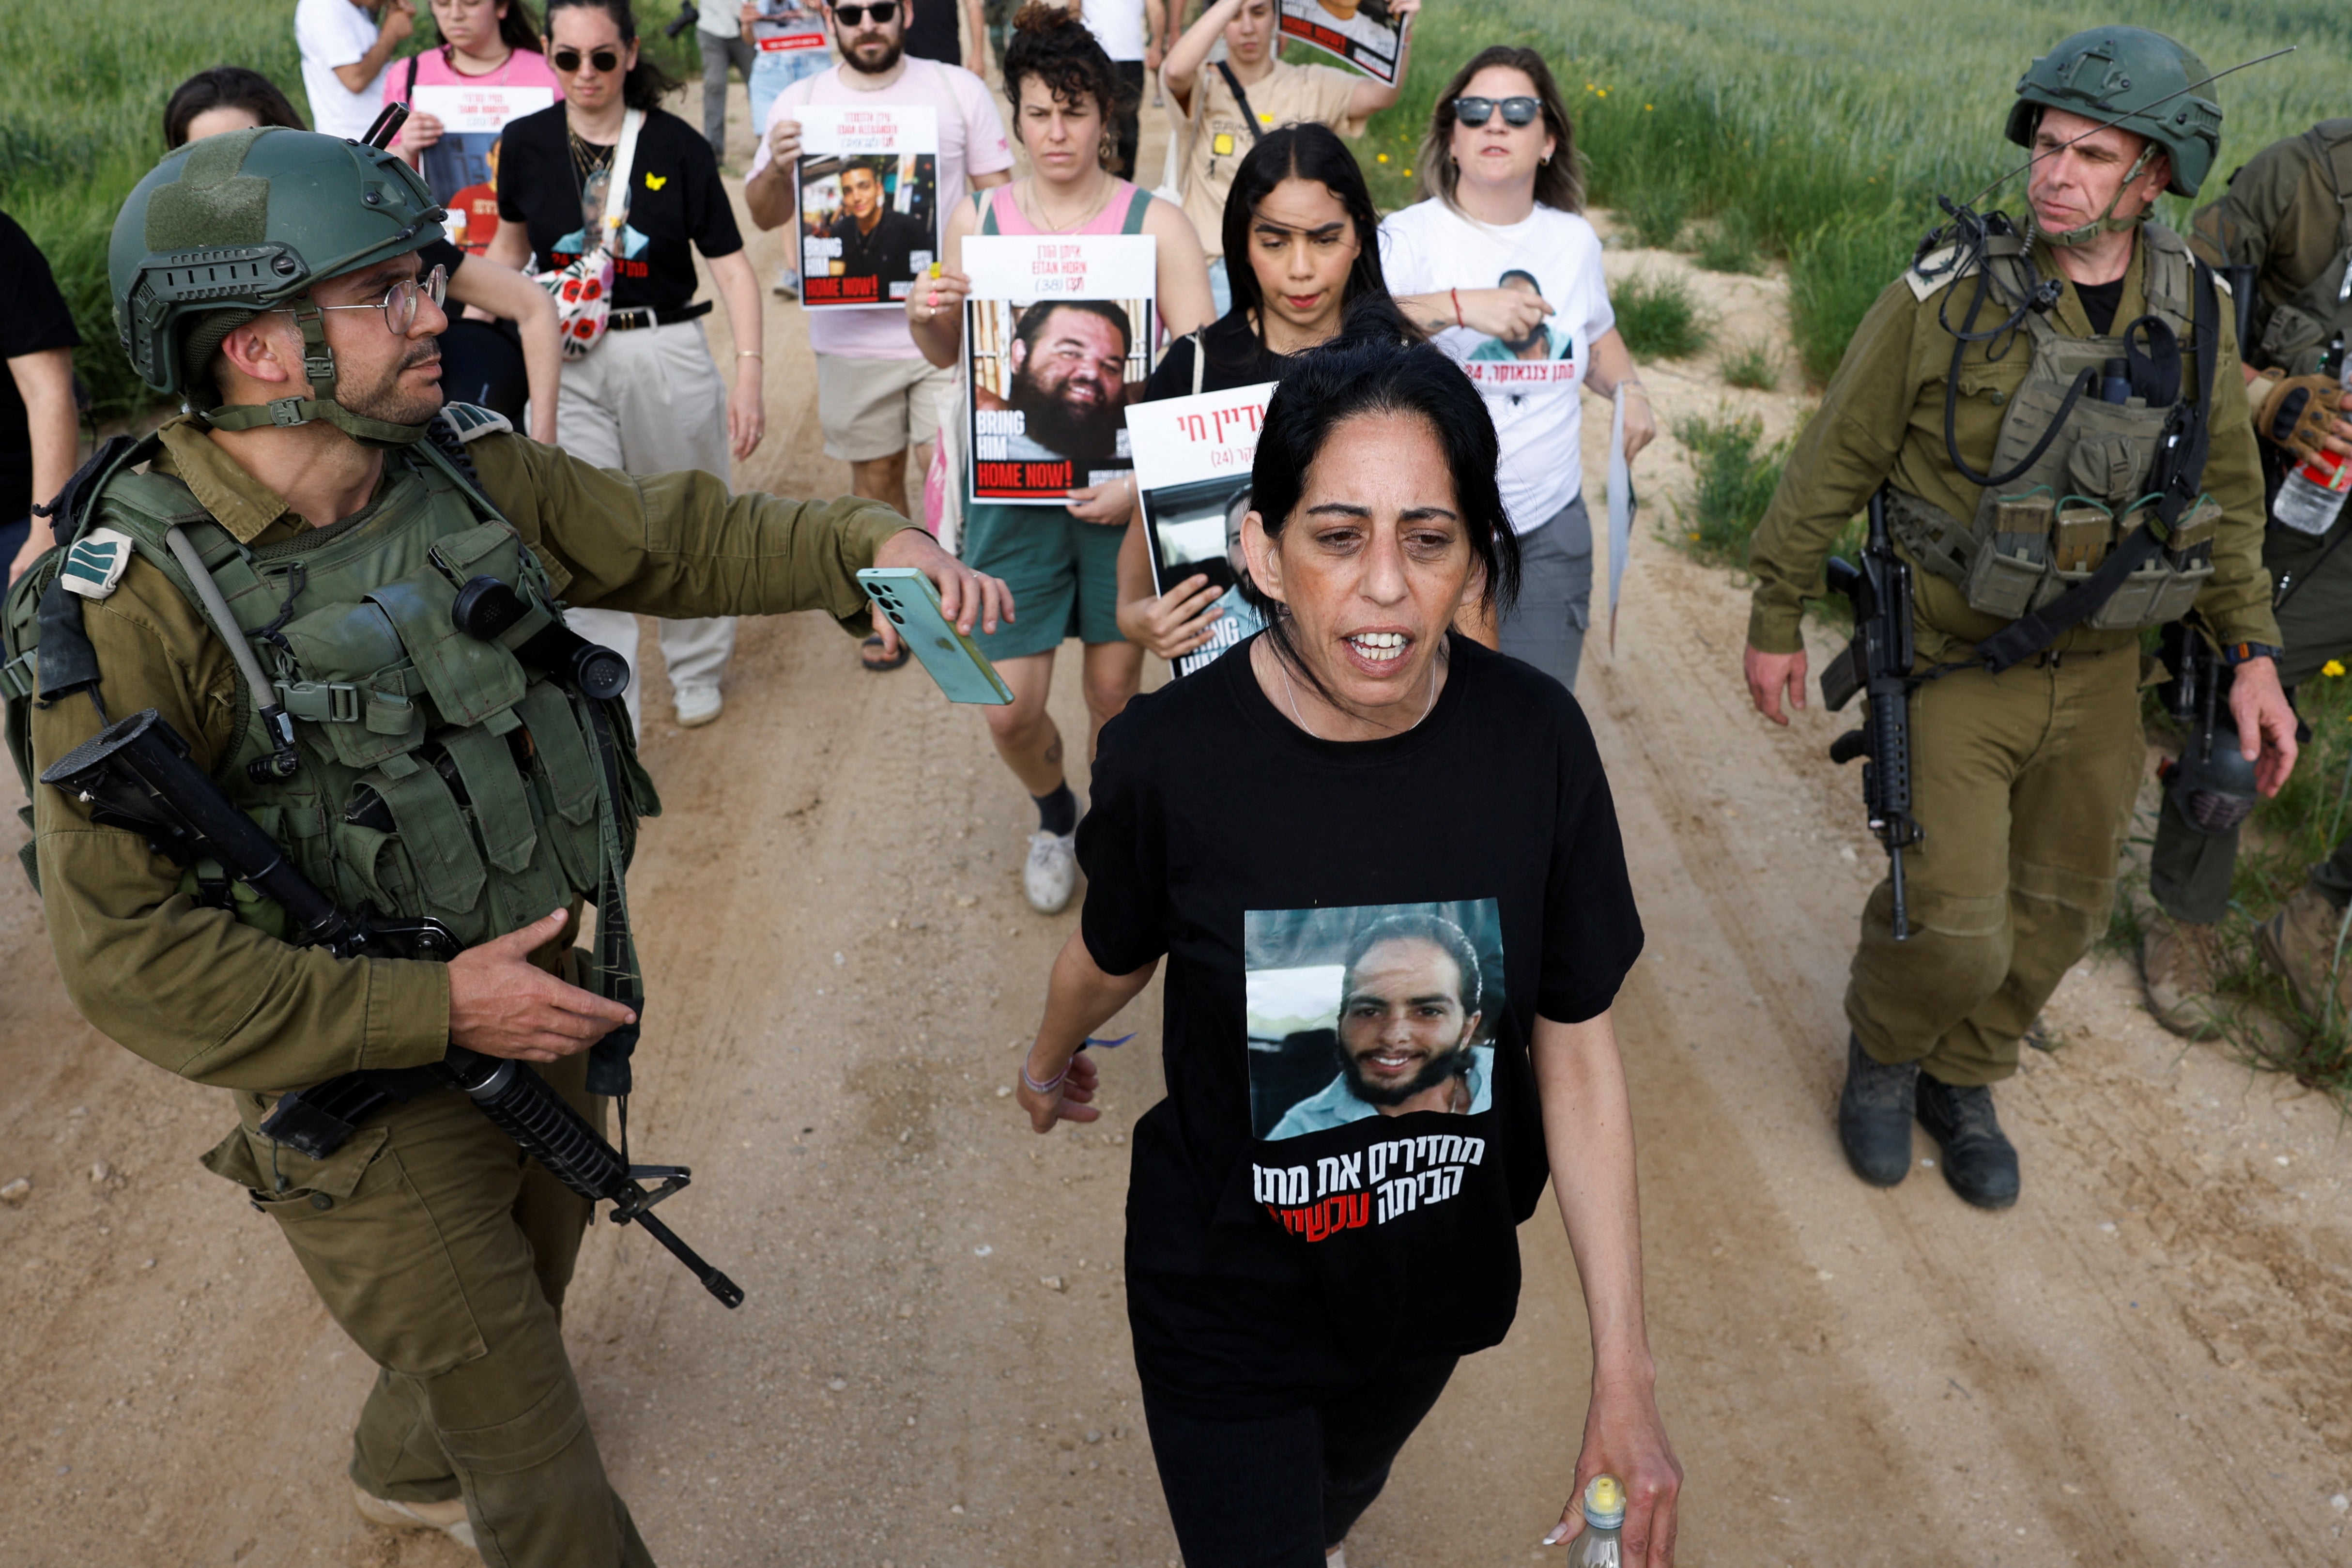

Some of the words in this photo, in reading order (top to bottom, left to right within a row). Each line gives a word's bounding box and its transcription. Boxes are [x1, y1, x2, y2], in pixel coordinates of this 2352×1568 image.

[803, 235, 843, 258] BRING
[804, 257, 830, 277] HIM
[1032, 261, 1058, 275] EITAN
[1061, 261, 1087, 274] HORN
[805, 277, 840, 297] HOME
[843, 274, 878, 296] NOW!
[1553, 364, 1574, 383] מתן
[976, 410, 1025, 436] BRING
[1177, 414, 1207, 442] חי
[976, 435, 1008, 461] HIM
[1211, 448, 1234, 468] (24)
[977, 462, 1023, 488] HOME
[1025, 460, 1074, 488] NOW!
[1368, 1135, 1485, 1184] מחזירים
[1253, 1163, 1309, 1205] מתן
[1317, 1151, 1361, 1198] את
[1377, 1166, 1464, 1225] הביתה
